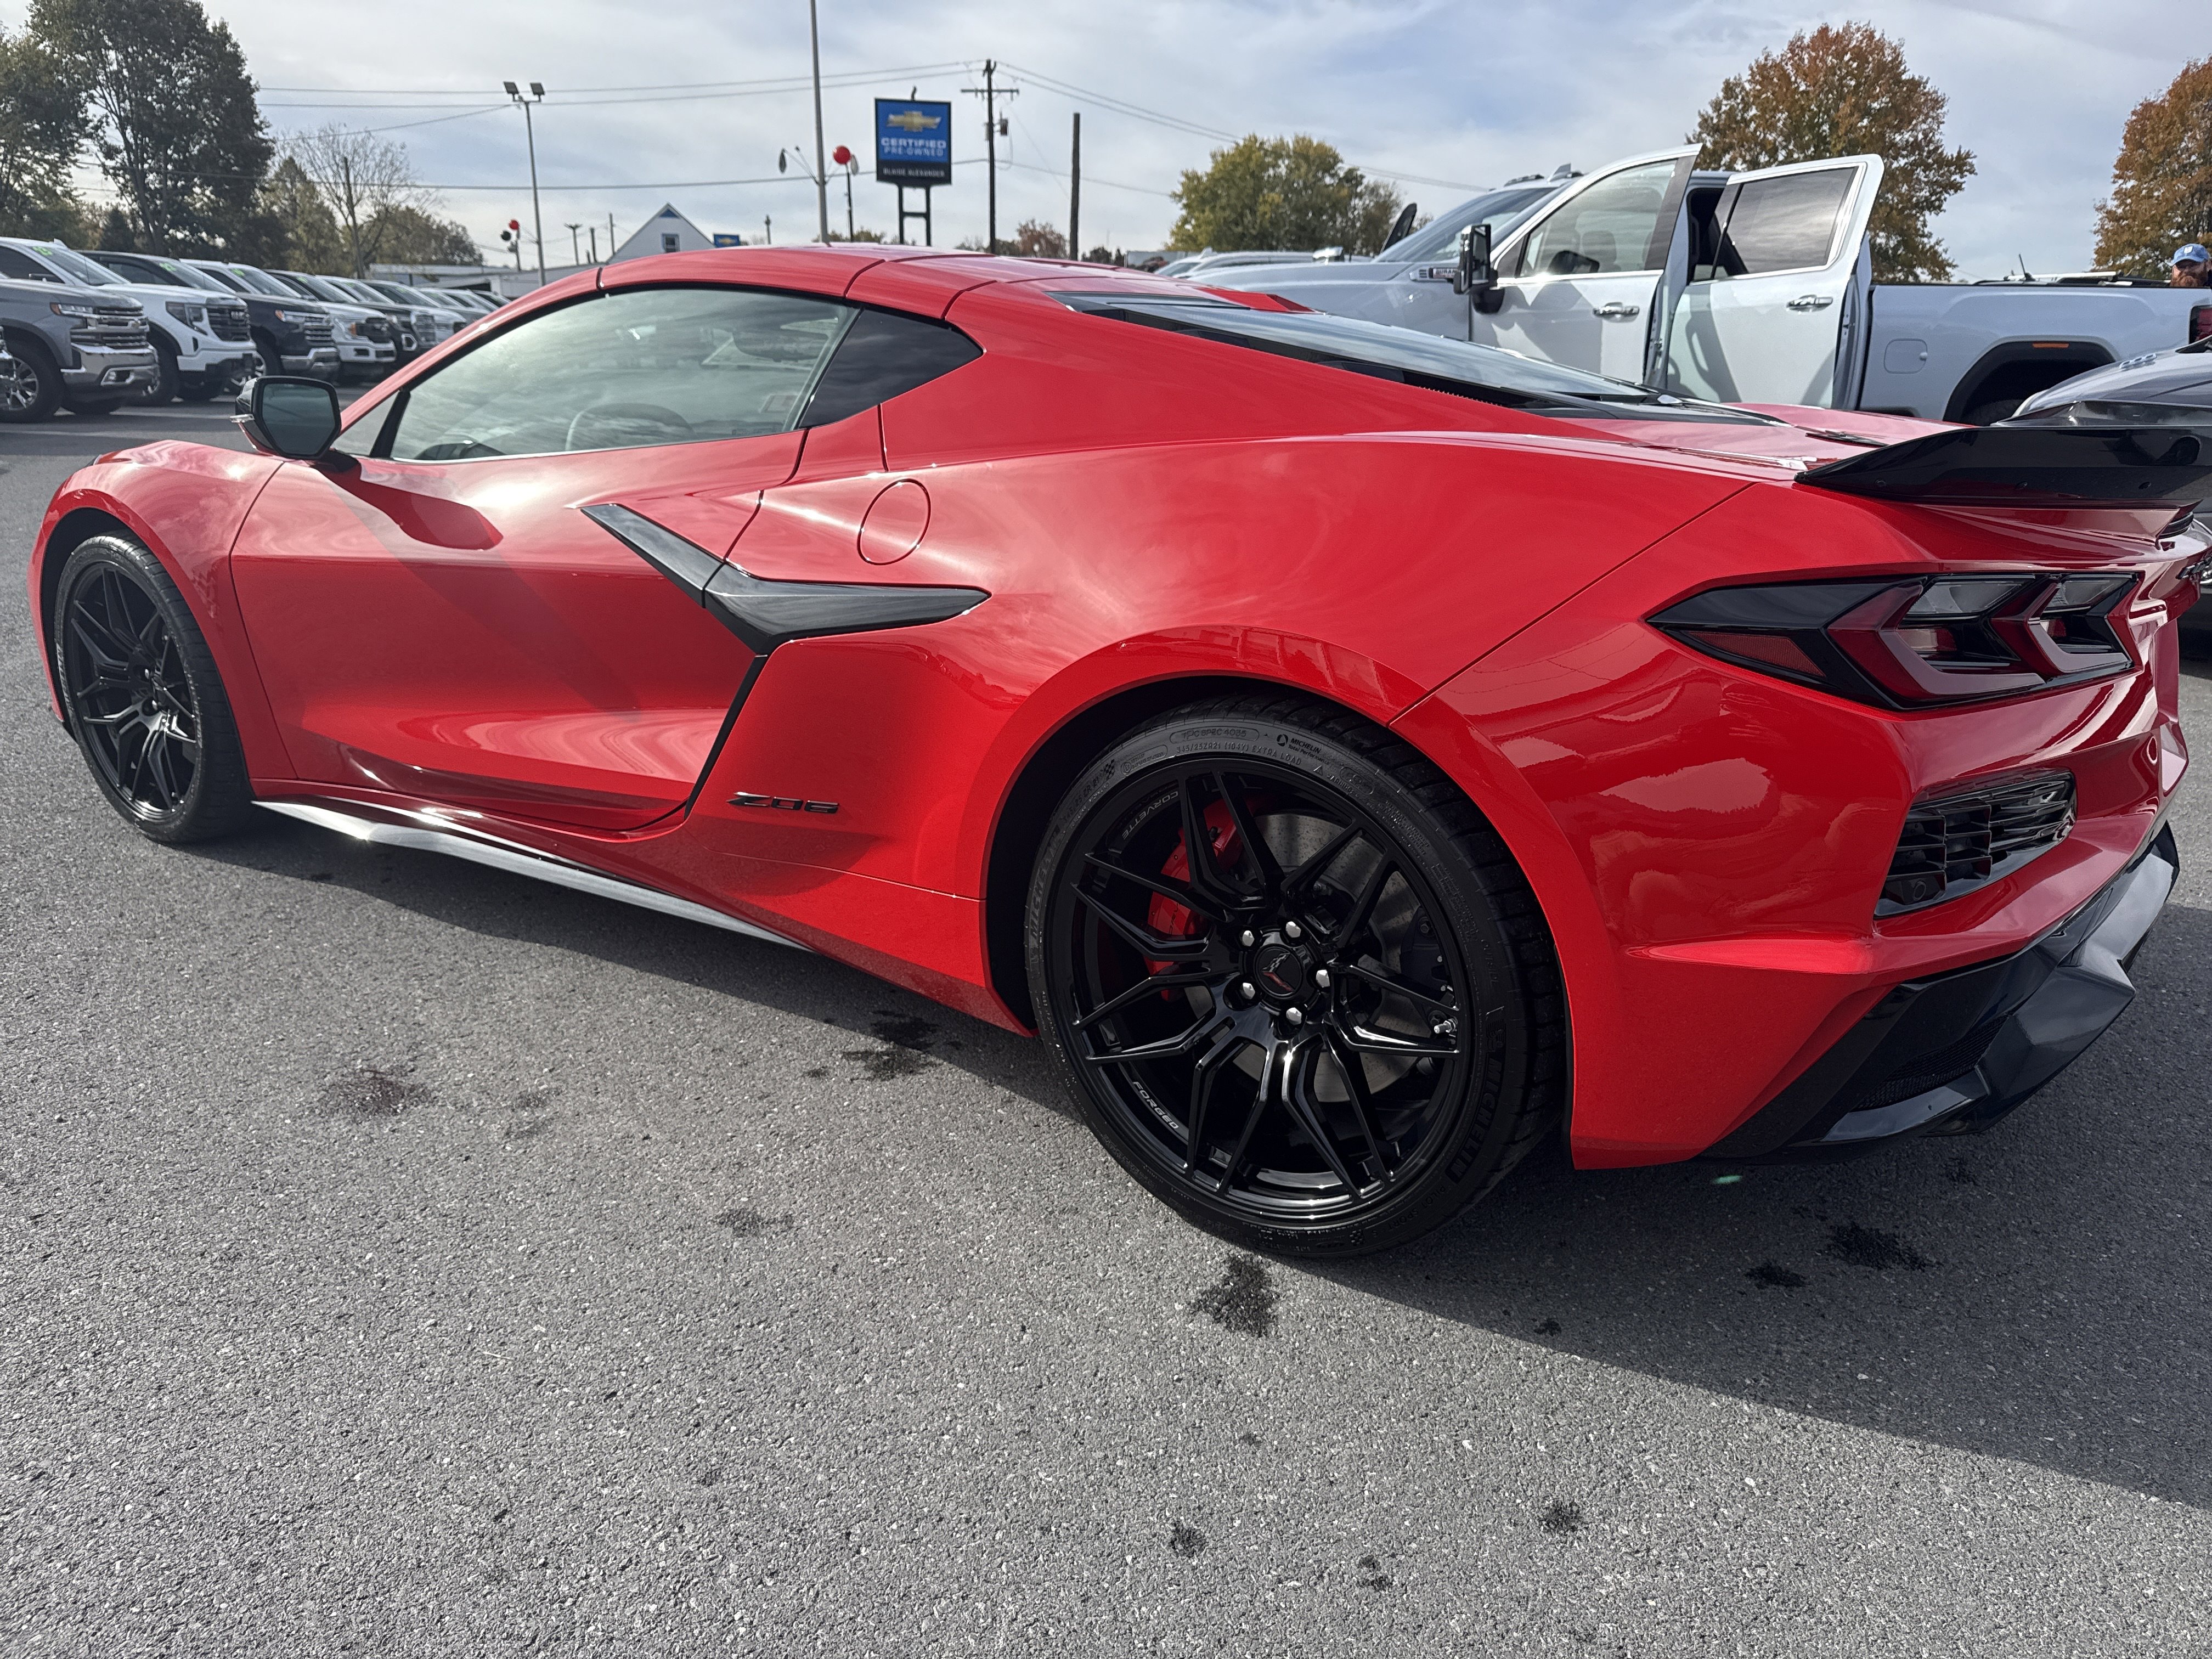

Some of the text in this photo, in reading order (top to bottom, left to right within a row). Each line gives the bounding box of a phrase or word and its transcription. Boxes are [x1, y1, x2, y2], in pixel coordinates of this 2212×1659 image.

[881, 138, 946, 149] CERTIFIED
[1252, 746, 1277, 757] EXTRA
[1280, 751, 1302, 765] LOAD
[1290, 738, 1321, 754] MICHELIN
[726, 792, 840, 814] Z06
[1121, 791, 1178, 840] CORVETTE
[1132, 1082, 1179, 1129] FORGED
[1449, 1057, 1502, 1180] MICHELIN
[1421, 1185, 1446, 1209] PILOT
[1387, 1207, 1419, 1231] SPORT
